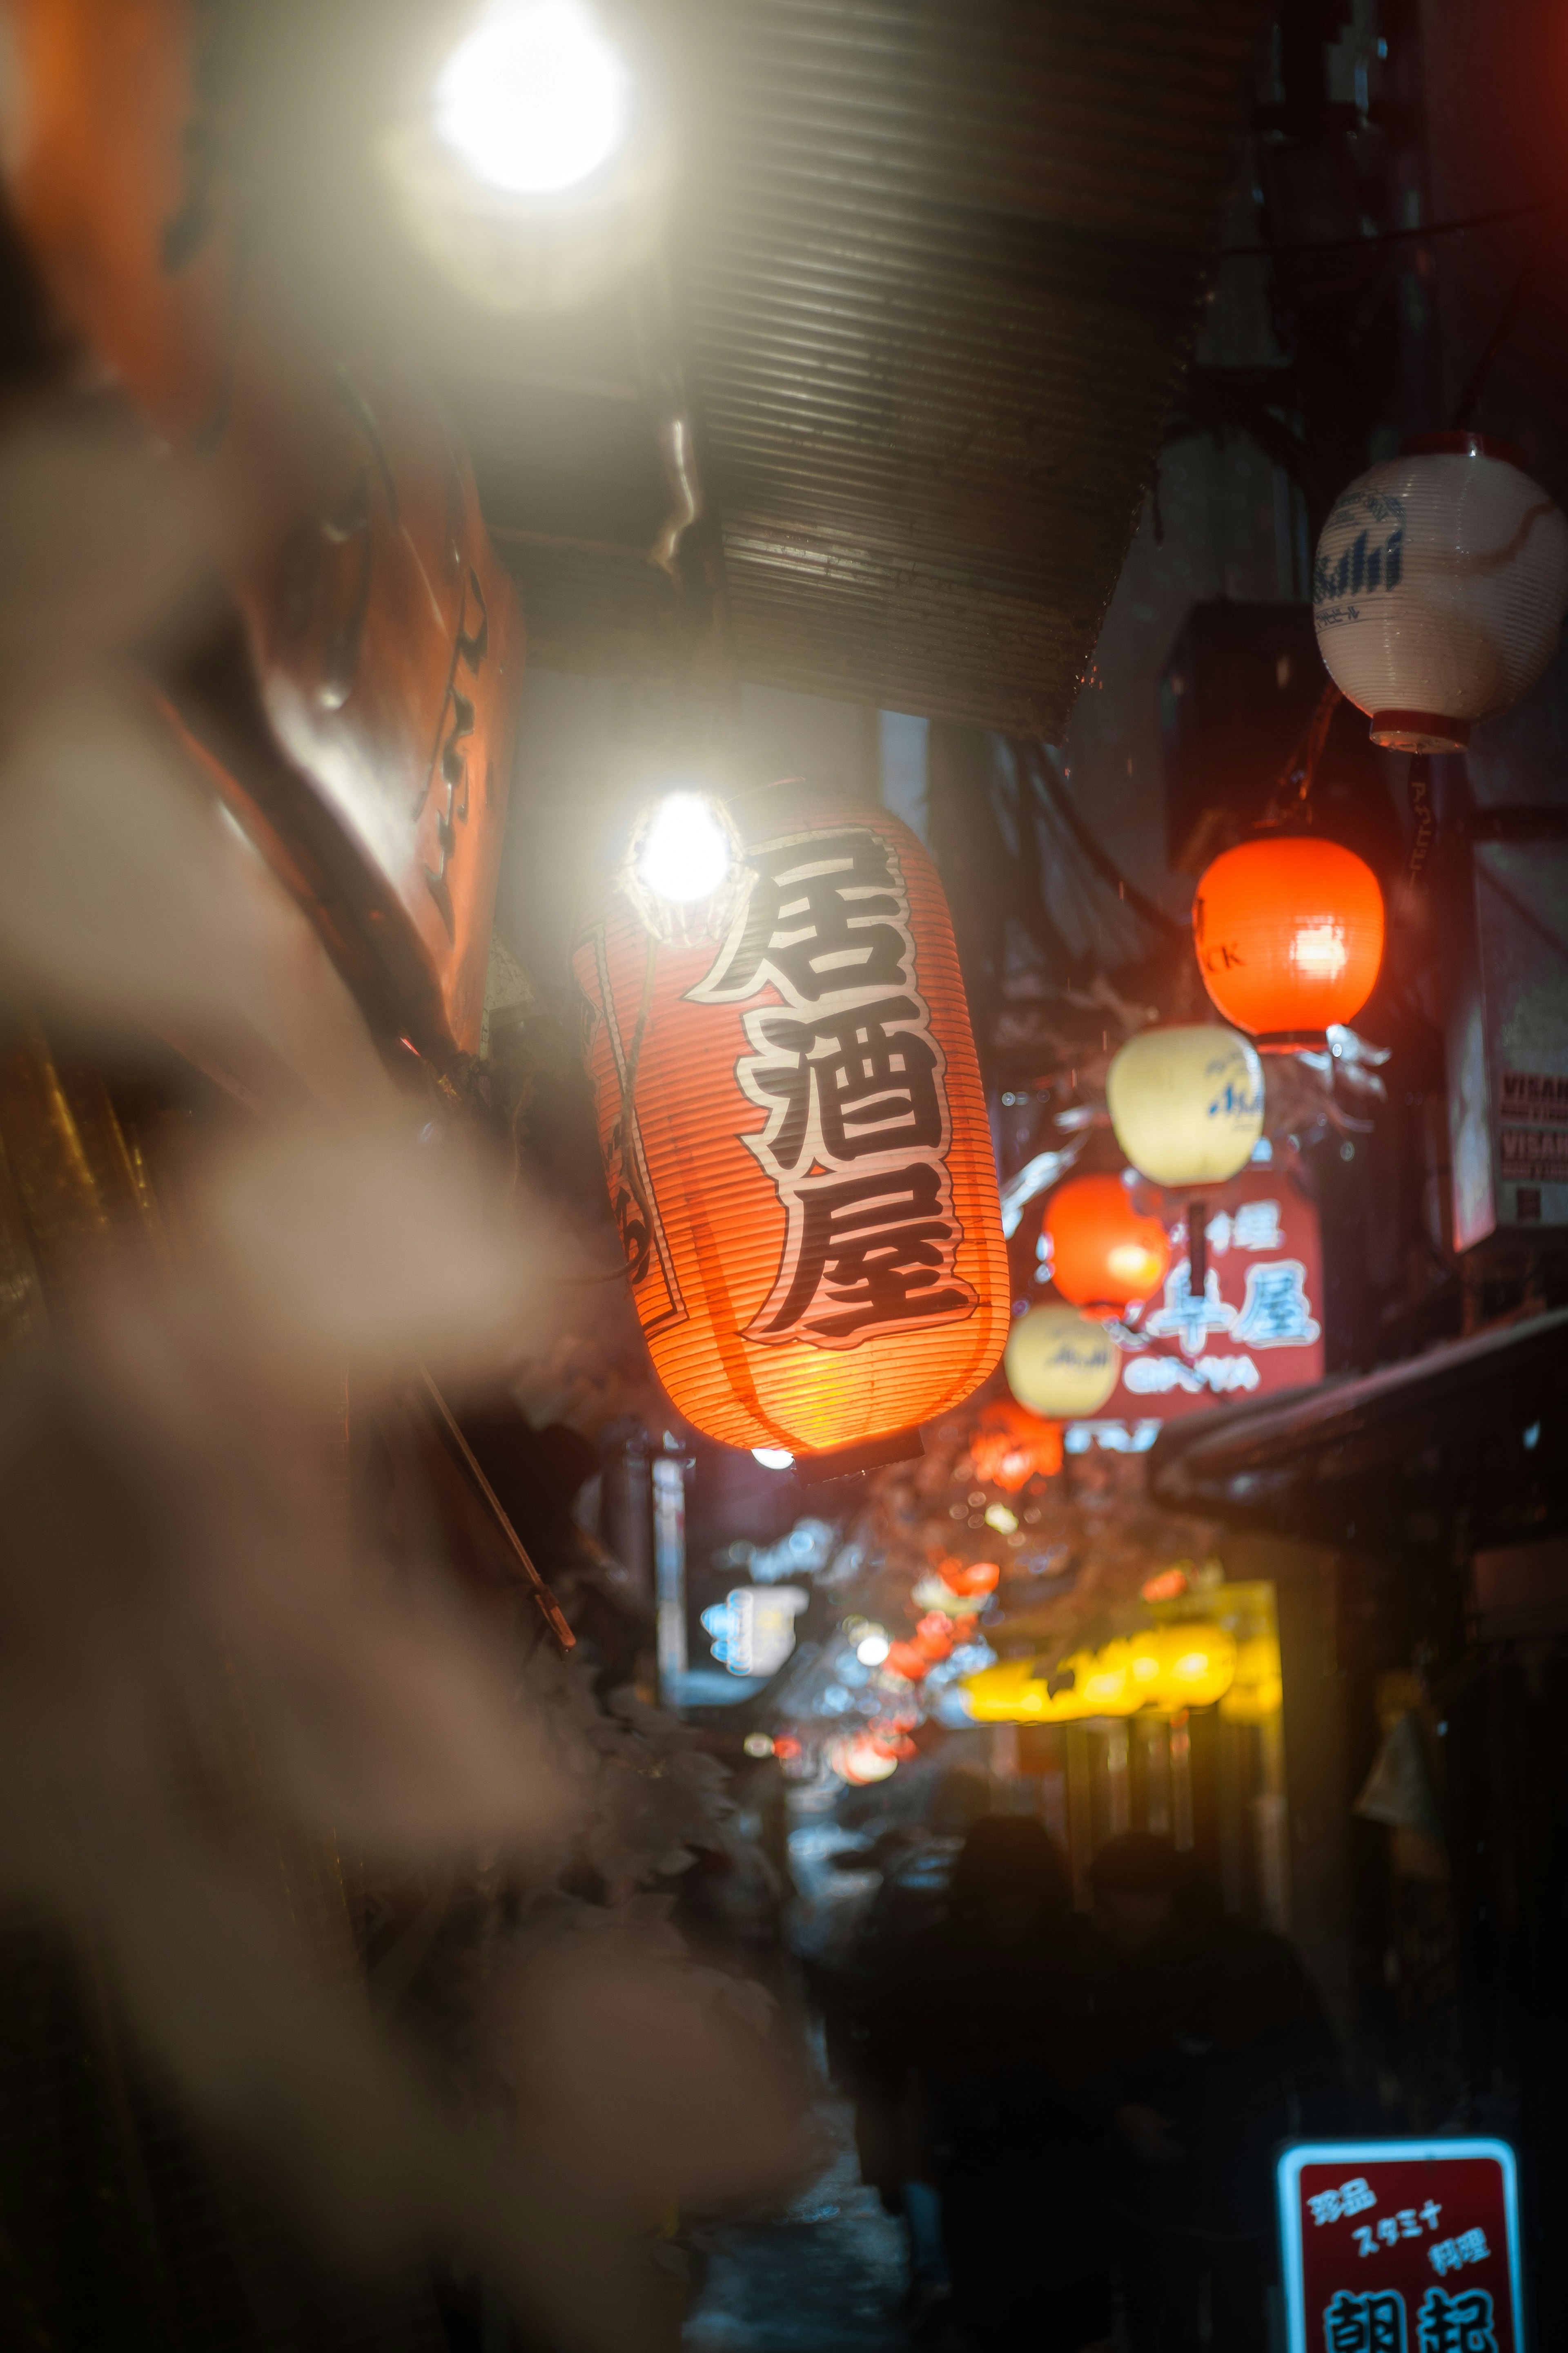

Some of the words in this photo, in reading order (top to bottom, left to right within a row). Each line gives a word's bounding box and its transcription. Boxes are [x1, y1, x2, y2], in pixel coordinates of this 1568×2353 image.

[684, 825, 980, 1350] 居酒屋
[1352, 2199, 1442, 2258] スタミナ
